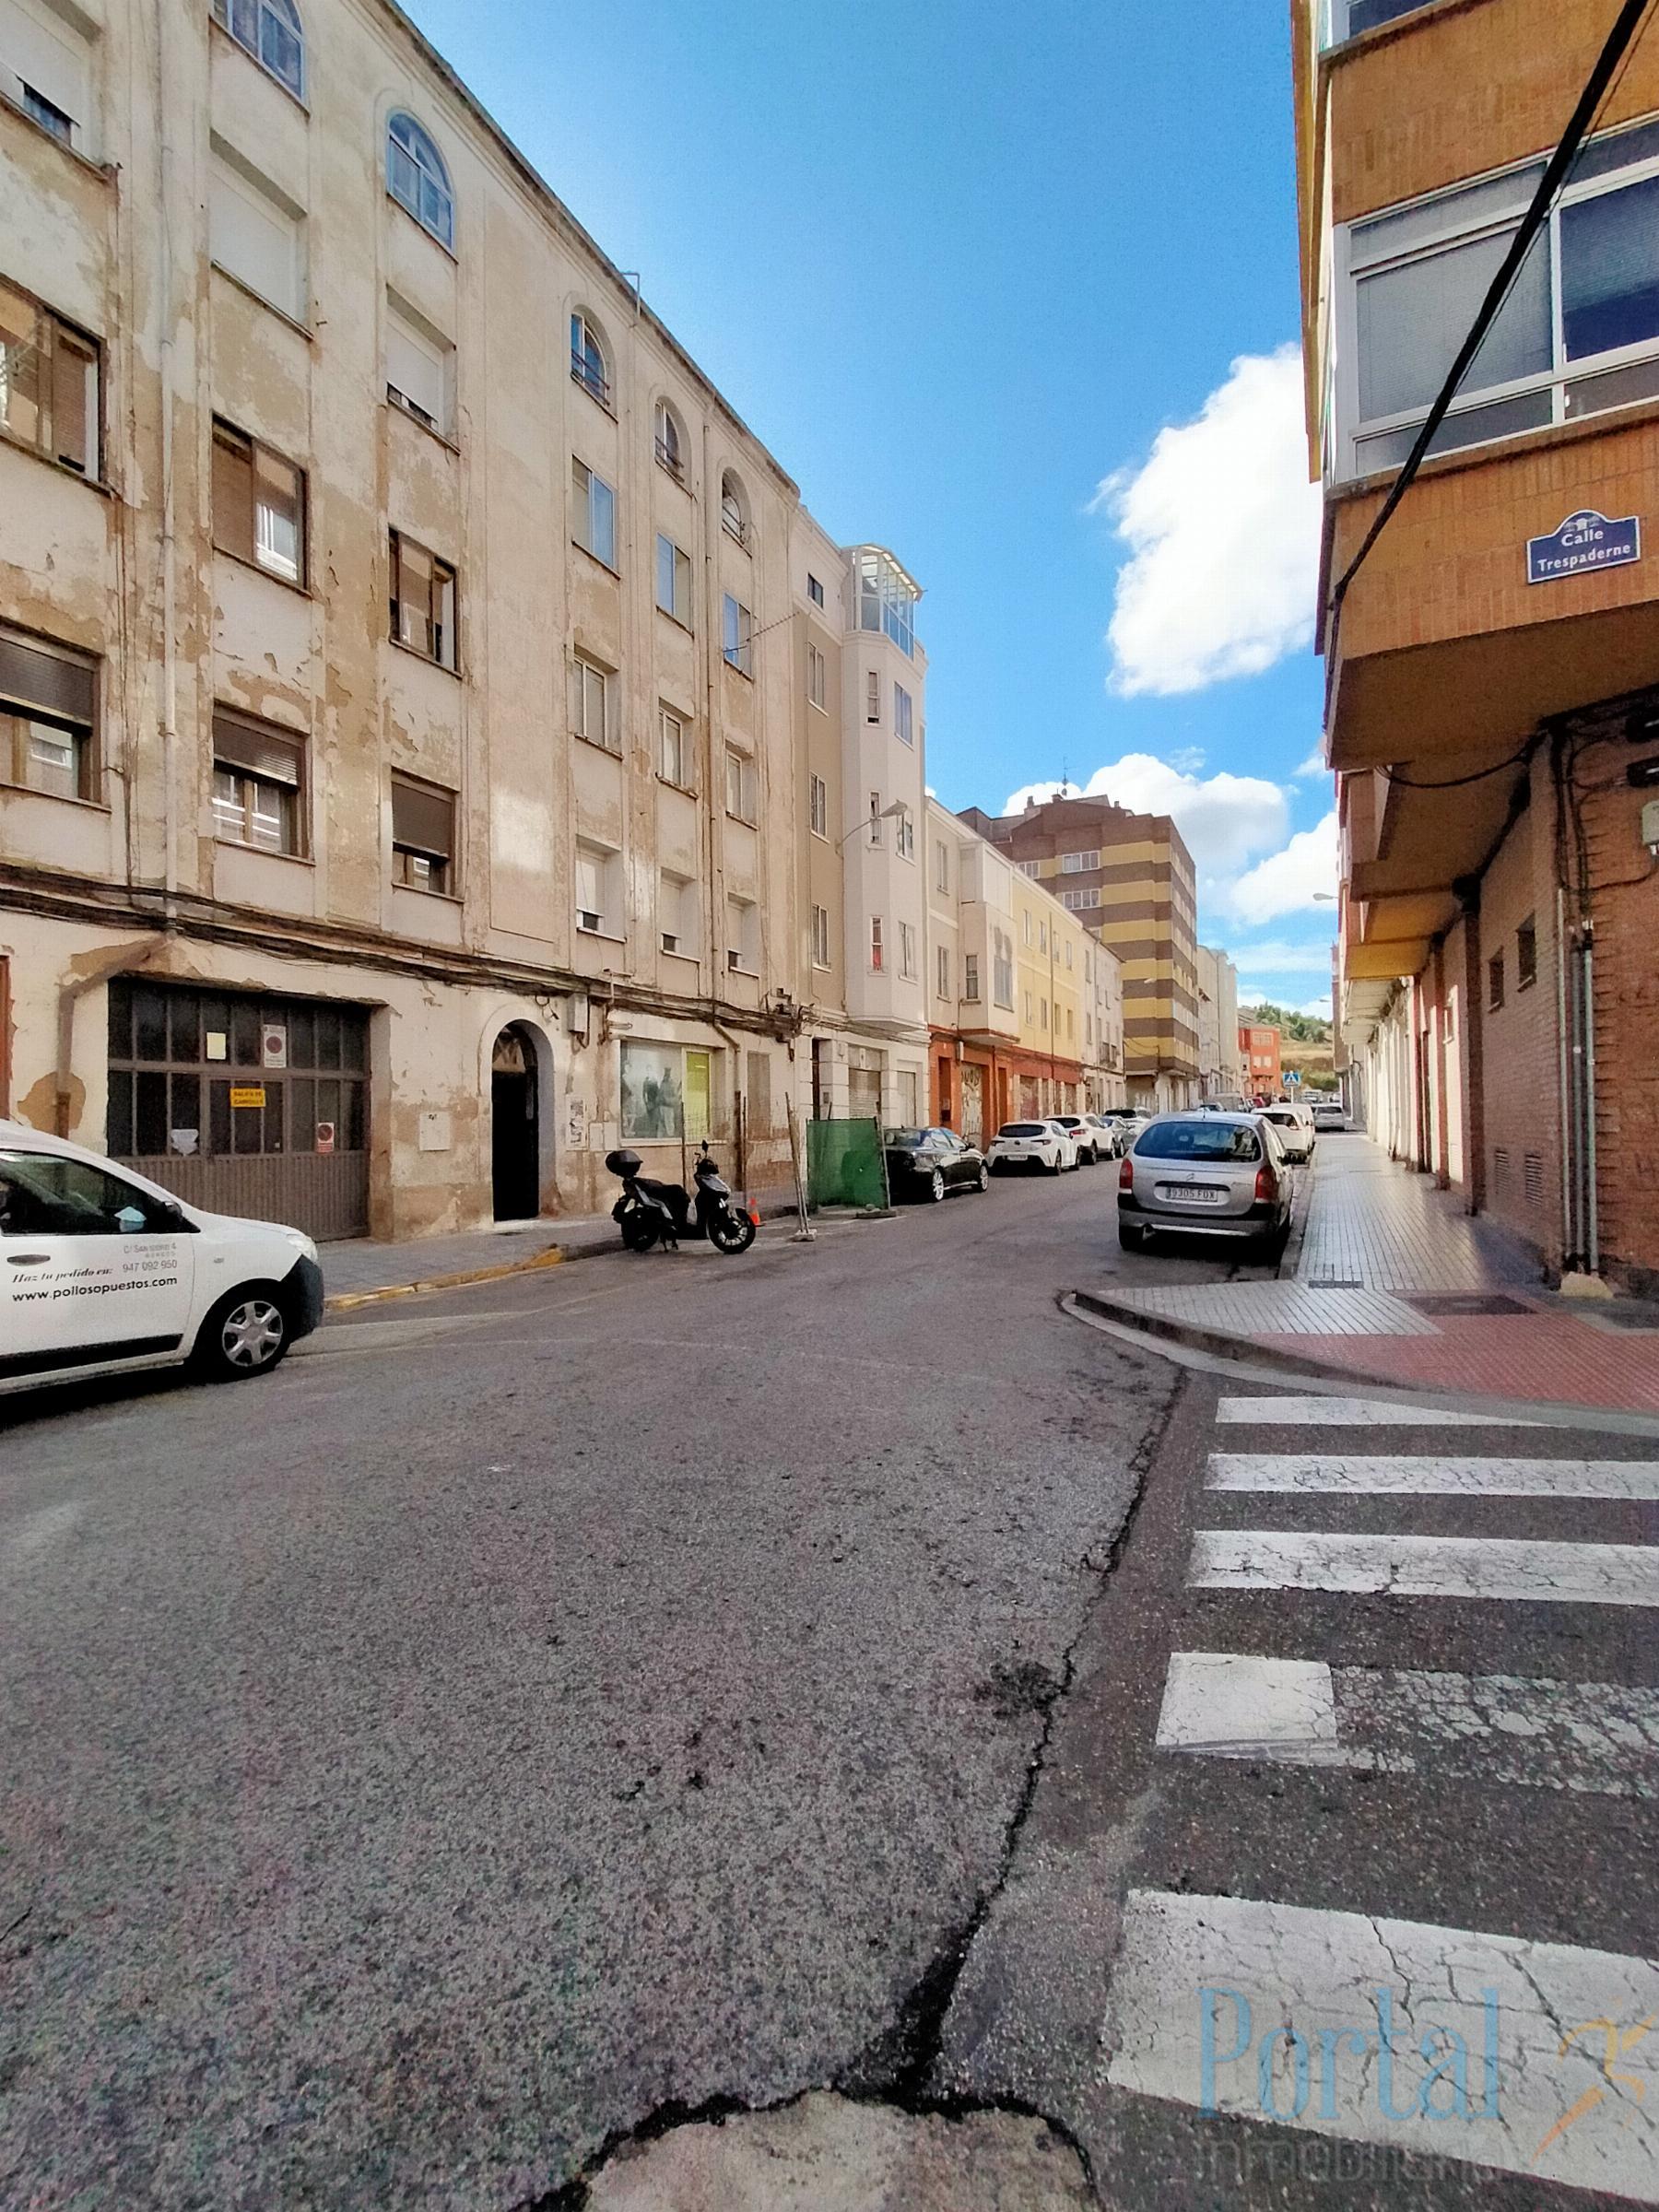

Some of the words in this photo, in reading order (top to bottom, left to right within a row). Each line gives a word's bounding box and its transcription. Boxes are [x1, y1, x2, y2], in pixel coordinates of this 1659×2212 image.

[1561, 529, 1604, 547] Calle
[1537, 545, 1630, 571] Trespaderne
[141, 1261, 159, 1271] 092
[12, 1277, 177, 1301] www.pollosopuestos.com
